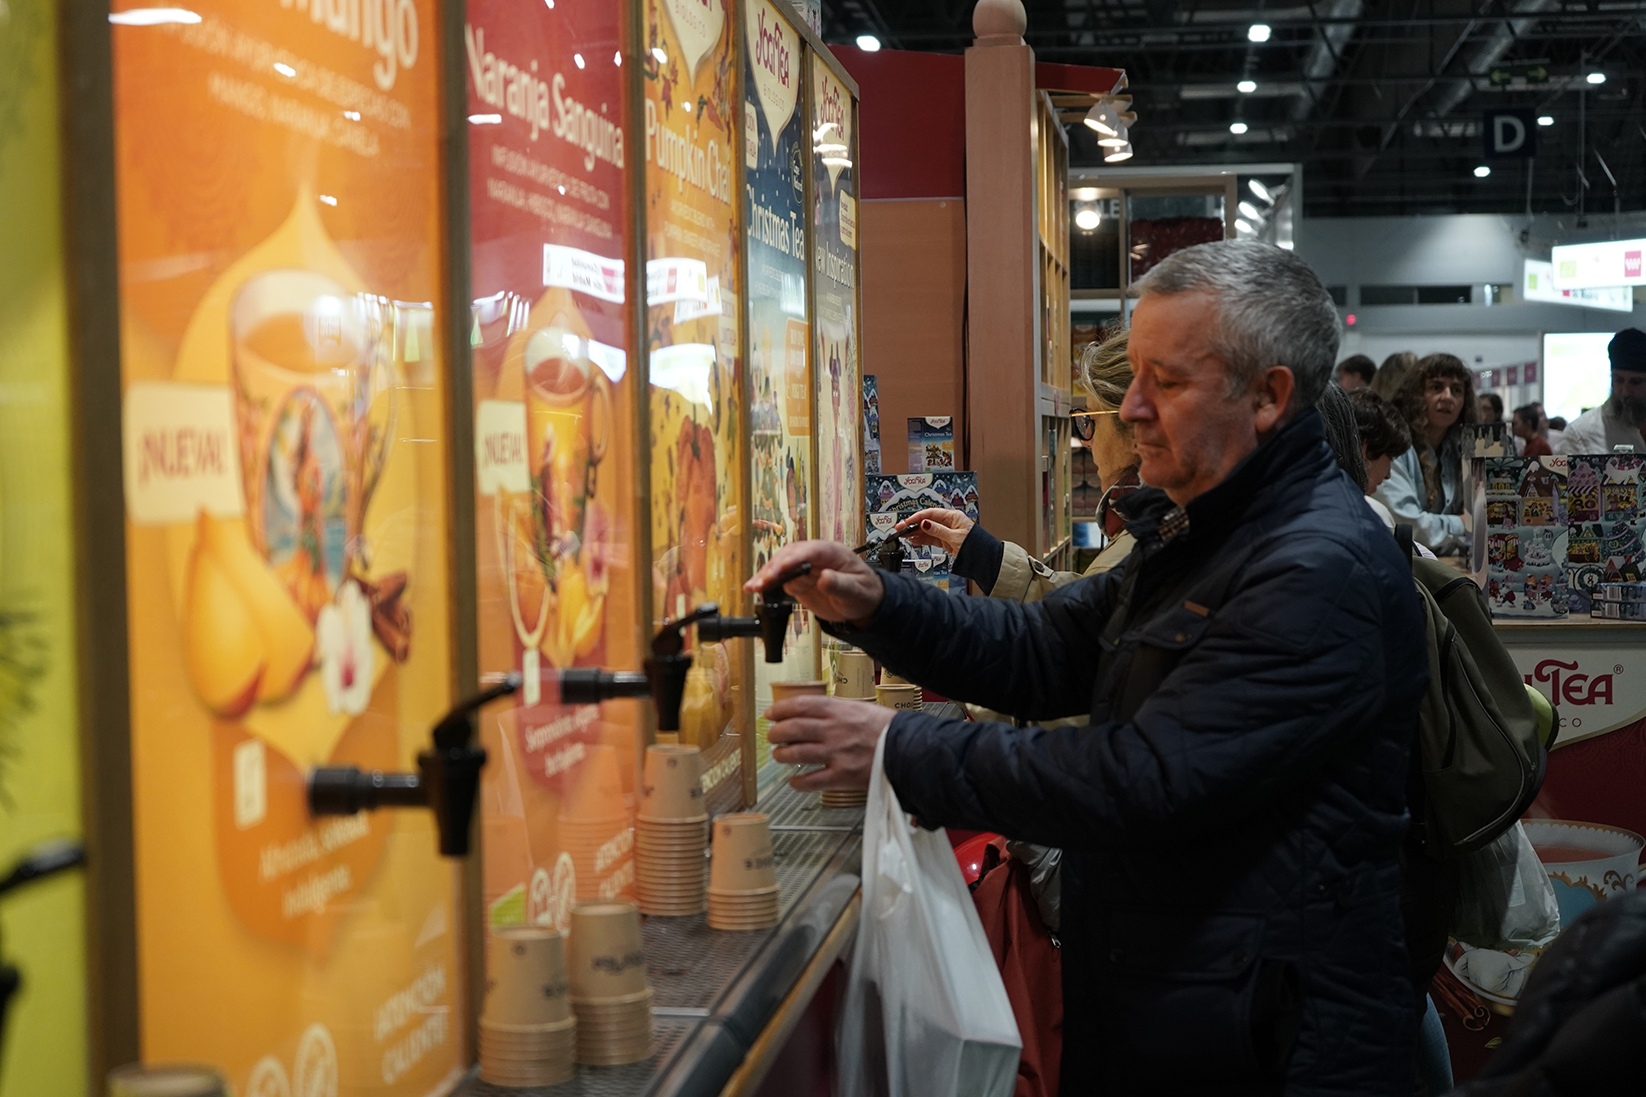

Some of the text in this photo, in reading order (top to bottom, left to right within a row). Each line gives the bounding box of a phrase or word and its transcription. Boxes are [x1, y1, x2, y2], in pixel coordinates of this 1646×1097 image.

[645, 98, 705, 193] Pumpkin
[1493, 115, 1526, 153] D
[789, 210, 805, 261] Tea
